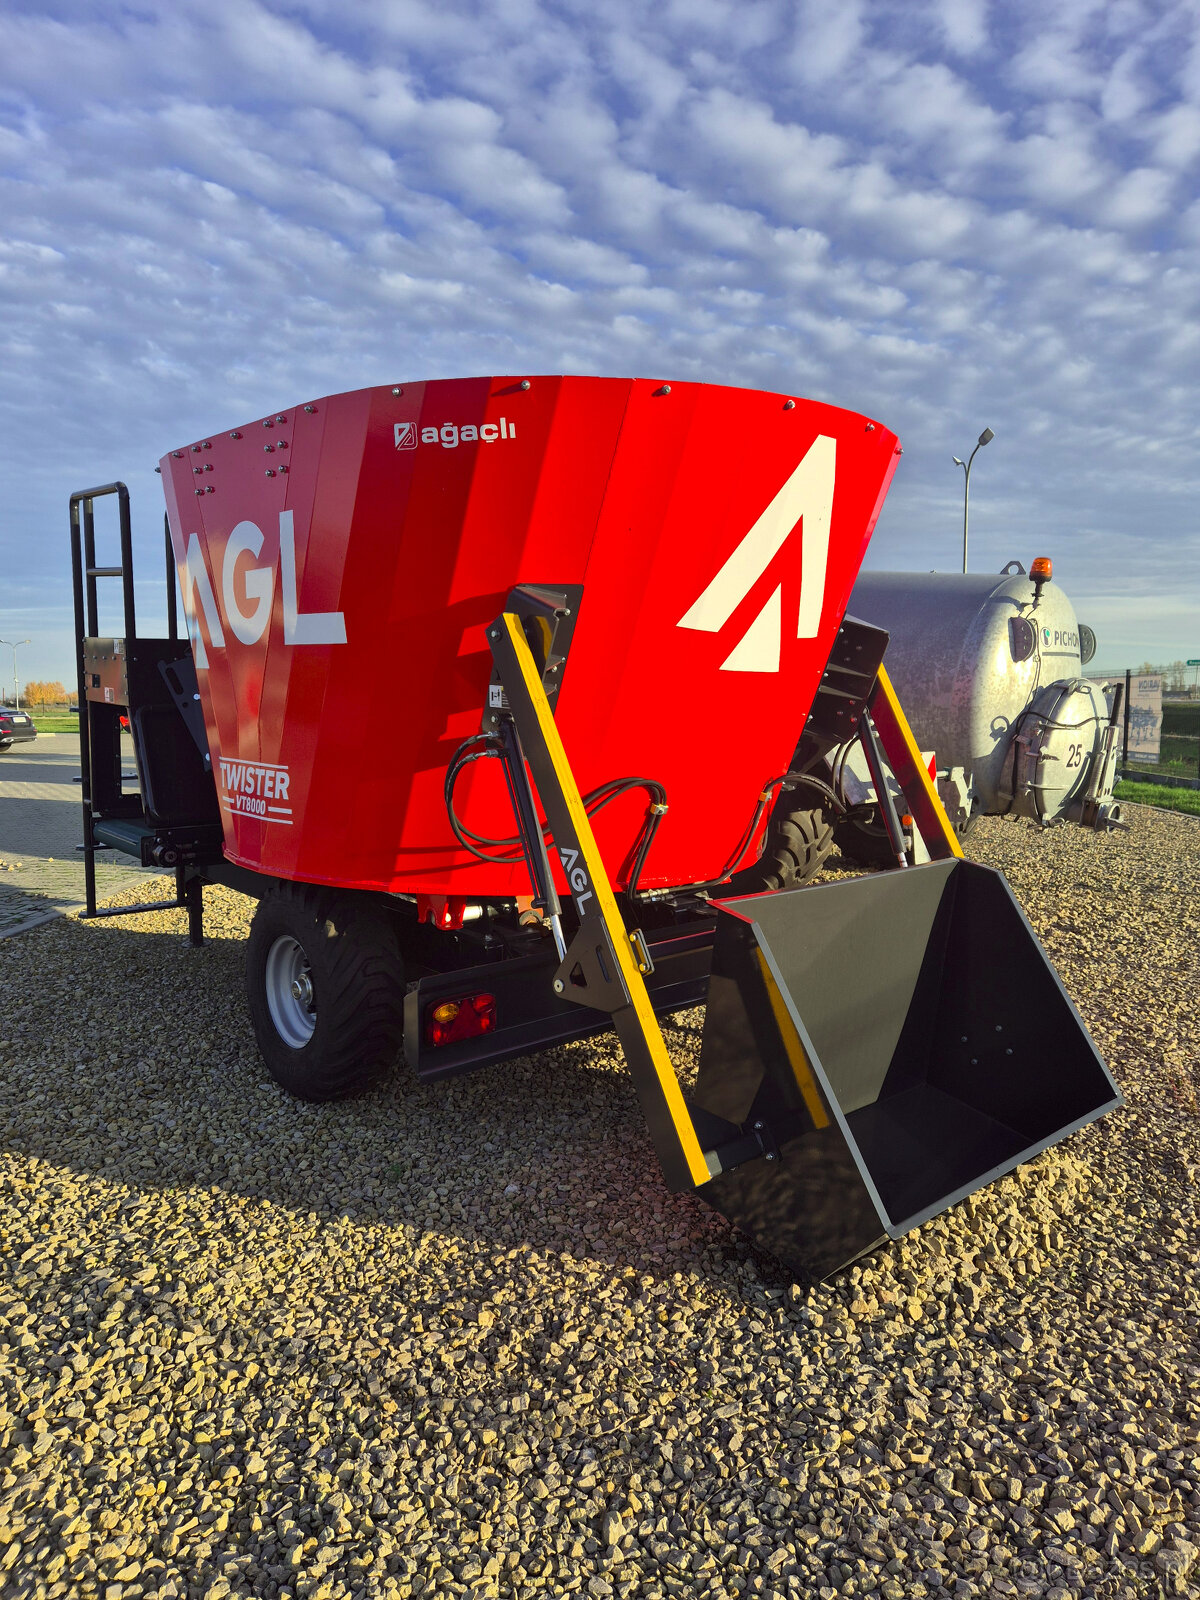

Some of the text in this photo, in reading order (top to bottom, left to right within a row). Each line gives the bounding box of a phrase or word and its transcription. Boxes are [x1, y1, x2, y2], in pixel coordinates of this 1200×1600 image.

[186, 510, 347, 669] AGL
[1066, 744, 1083, 768] 25
[220, 763, 290, 800] TWISTER
[236, 795, 266, 815] VT8000
[560, 847, 593, 916] AGL
